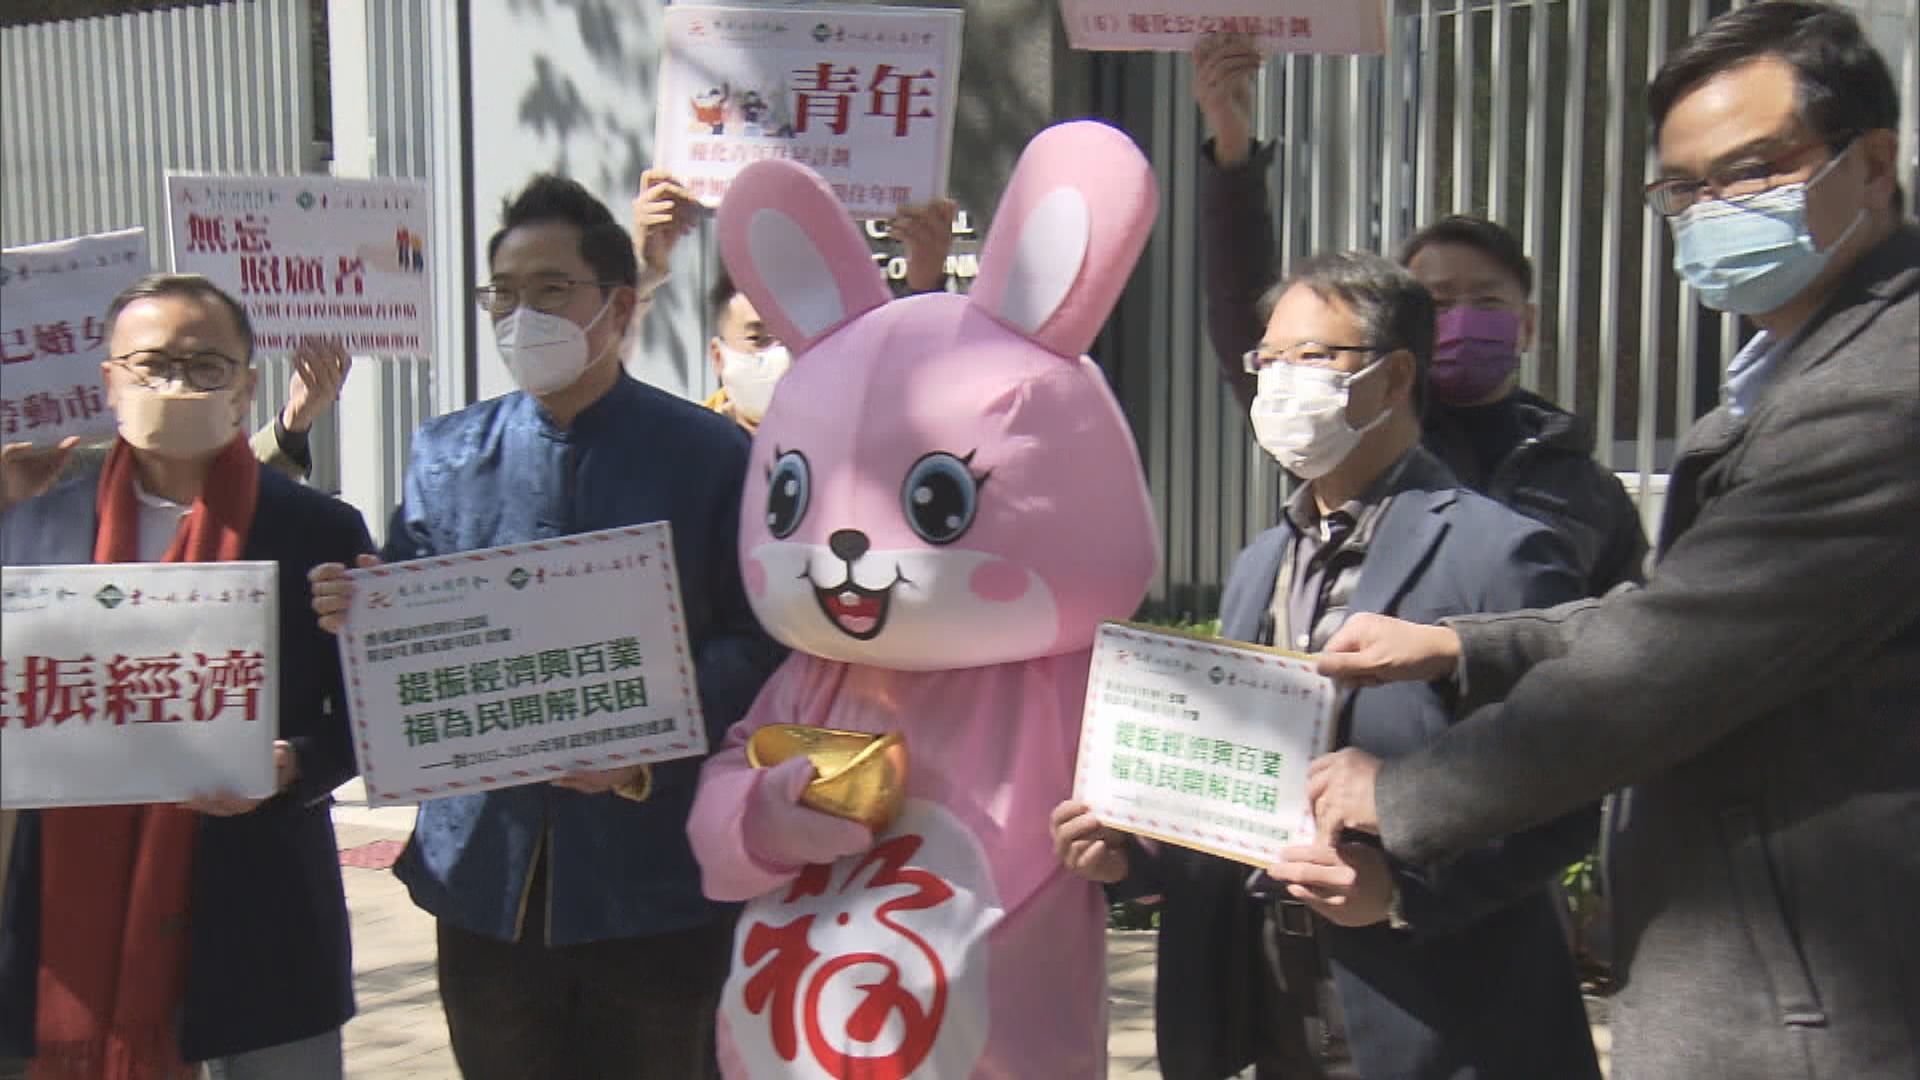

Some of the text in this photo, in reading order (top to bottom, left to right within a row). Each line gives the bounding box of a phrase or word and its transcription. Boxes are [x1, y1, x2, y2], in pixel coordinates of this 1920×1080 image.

[791, 63, 935, 137] 青年
[186, 213, 272, 253] 無忘
[240, 255, 366, 296] 照顧者
[0, 650, 265, 729] 振經濟
[396, 636, 642, 707] 提振經濟興百業
[403, 676, 648, 748] 福為民開解民困
